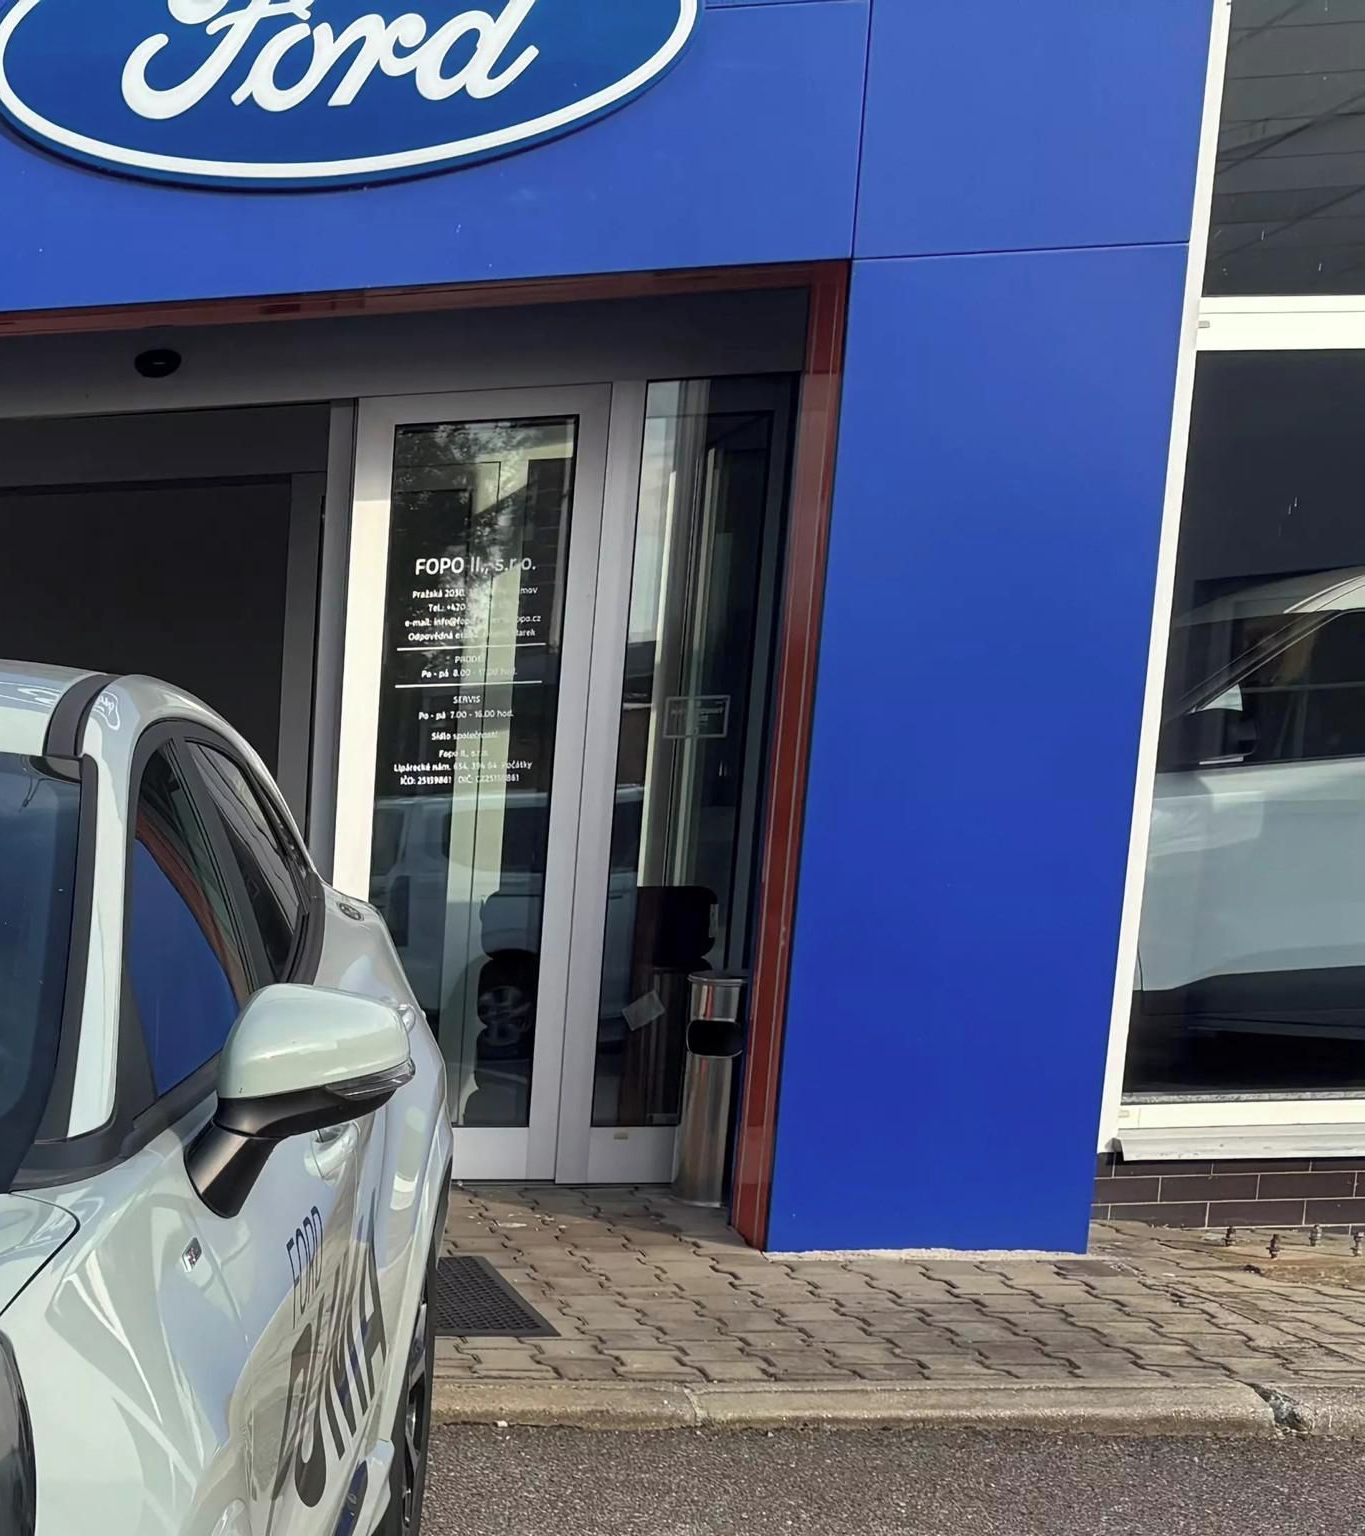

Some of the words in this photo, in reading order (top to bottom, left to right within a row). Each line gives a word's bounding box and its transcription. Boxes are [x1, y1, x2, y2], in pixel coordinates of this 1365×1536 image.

[121, 0, 539, 120] Ford
[415, 557, 465, 576] FOPO
[495, 557, 536, 572] s.ro.
[421, 670, 432, 678] Po
[452, 695, 481, 704] SERVIS
[418, 711, 429, 720] Po
[431, 731, 451, 740] Sídlo
[439, 749, 458, 759] Fopo
[286, 1205, 324, 1330] FORD
